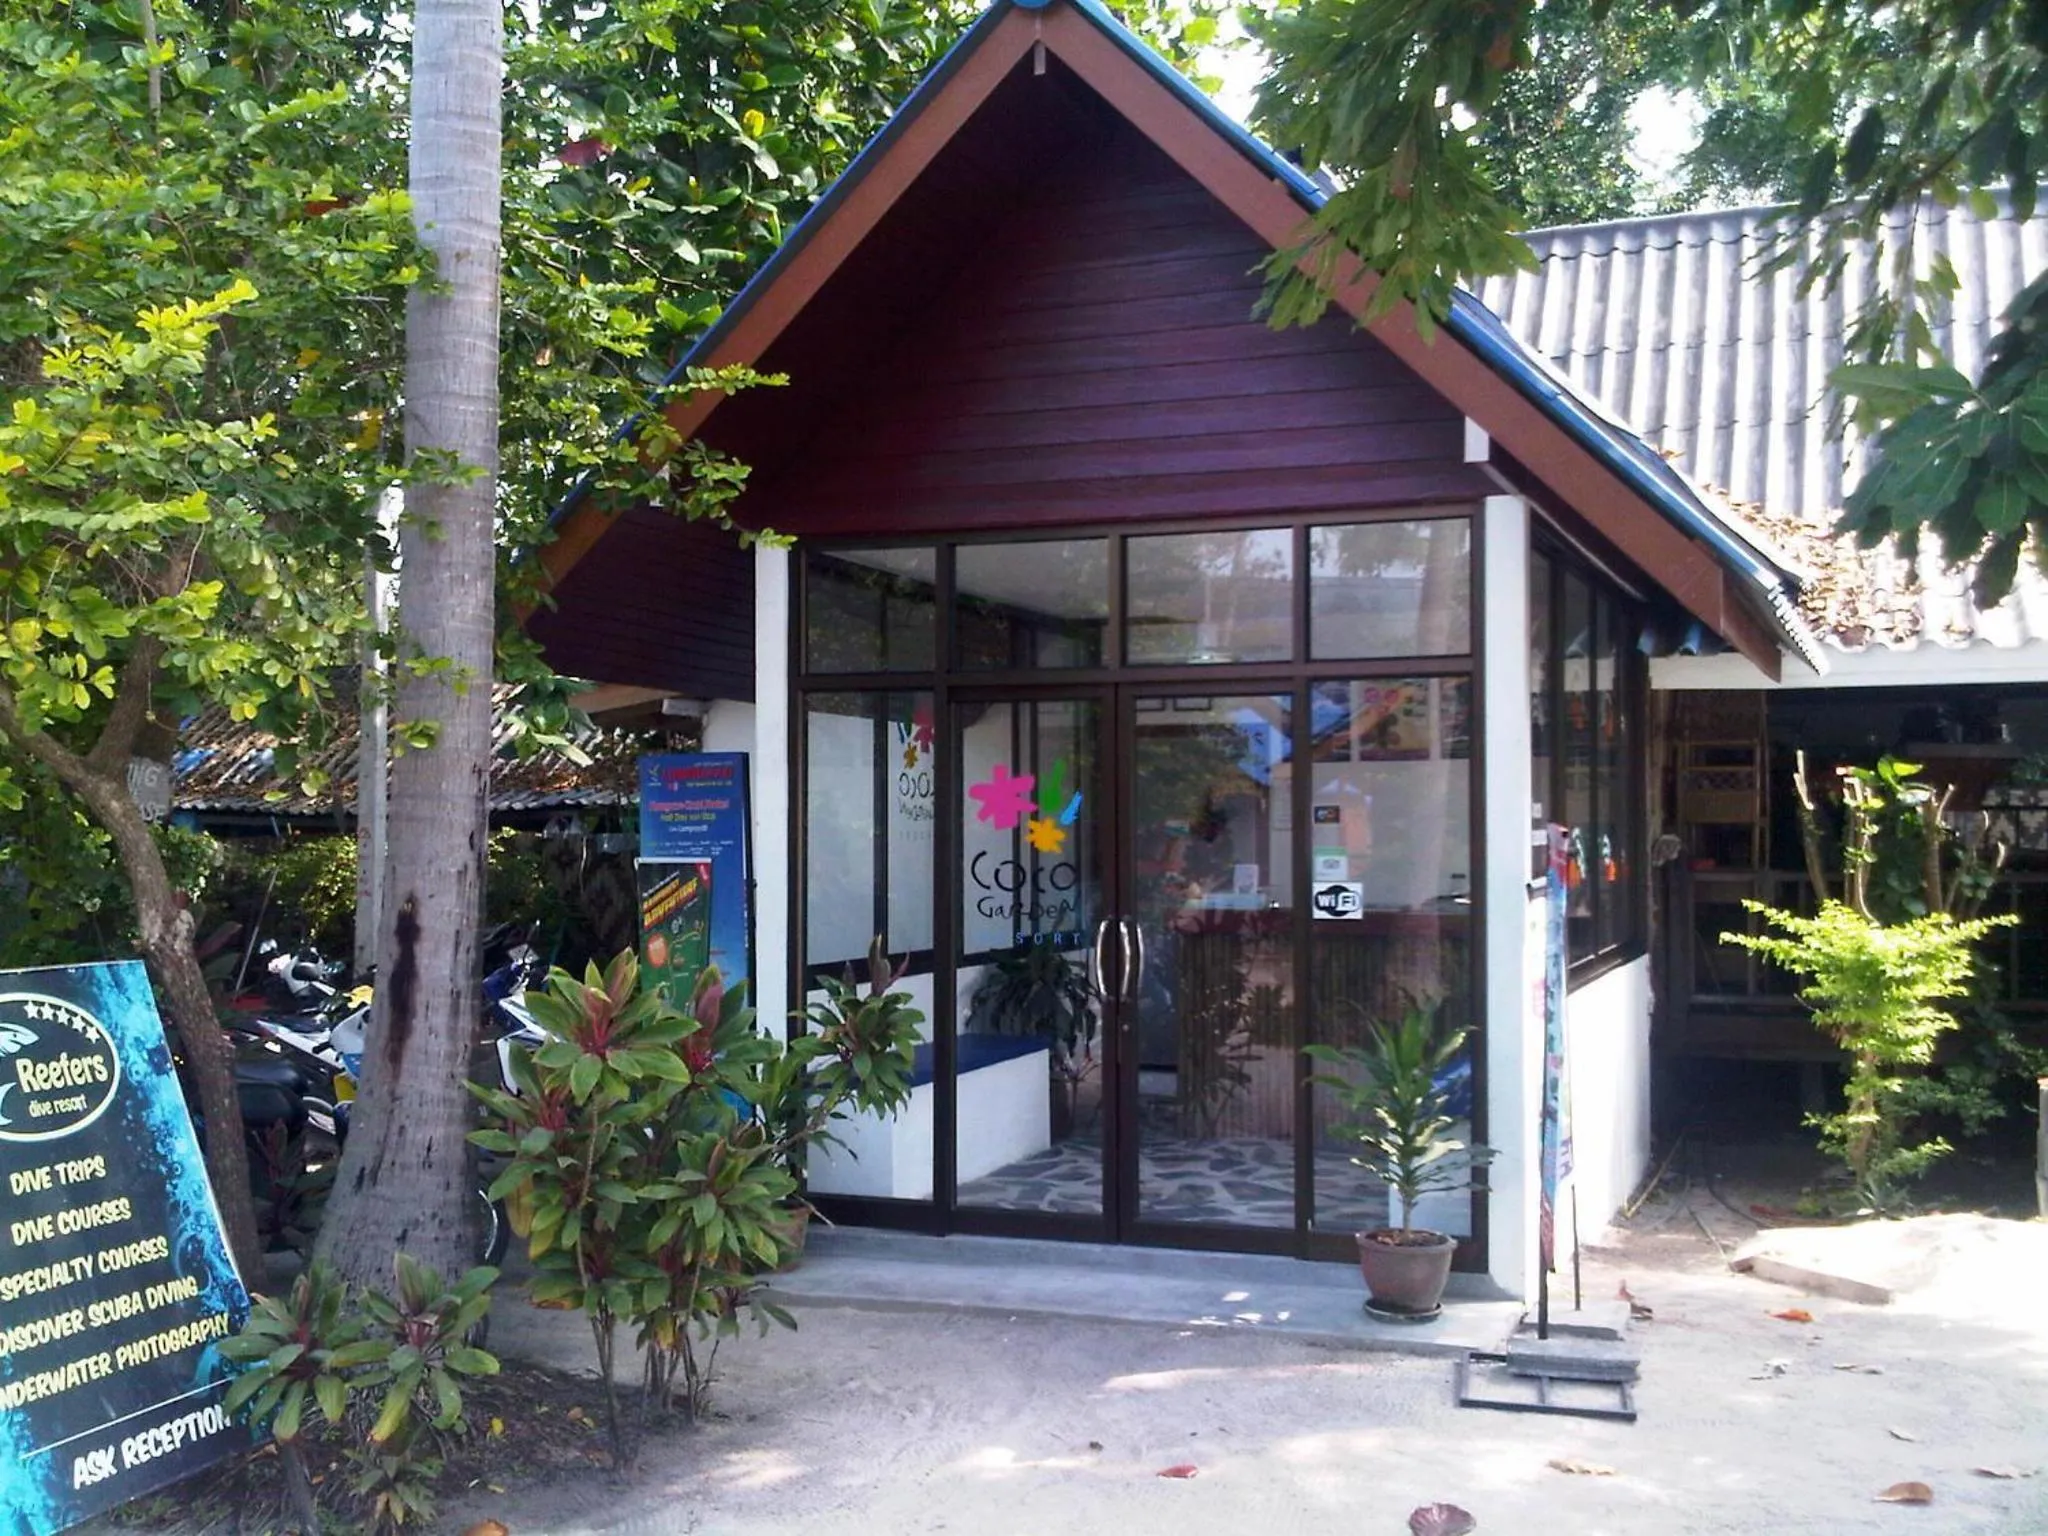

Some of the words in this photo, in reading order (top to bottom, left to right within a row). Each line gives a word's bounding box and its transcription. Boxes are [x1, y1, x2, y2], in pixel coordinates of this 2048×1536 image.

[16, 1052, 109, 1093] Reefers
[28, 1099, 54, 1117] dive
[54, 1093, 88, 1115] resort
[9, 1166, 52, 1195] DIVE
[54, 1155, 106, 1184] TRIPS
[11, 1217, 55, 1246] DIVE
[57, 1197, 132, 1235] COURSES
[0, 1254, 93, 1301] SPECIALTY
[98, 1236, 168, 1273] COURSES
[0, 1309, 86, 1357] DISCOVER
[88, 1292, 145, 1327] SCUBA
[146, 1275, 199, 1310] DIVING
[0, 1352, 113, 1411] NDERWATER
[115, 1312, 230, 1371] PHOTOGRAPHY
[73, 1444, 118, 1490] ASK
[121, 1403, 231, 1470] RECEPTION
